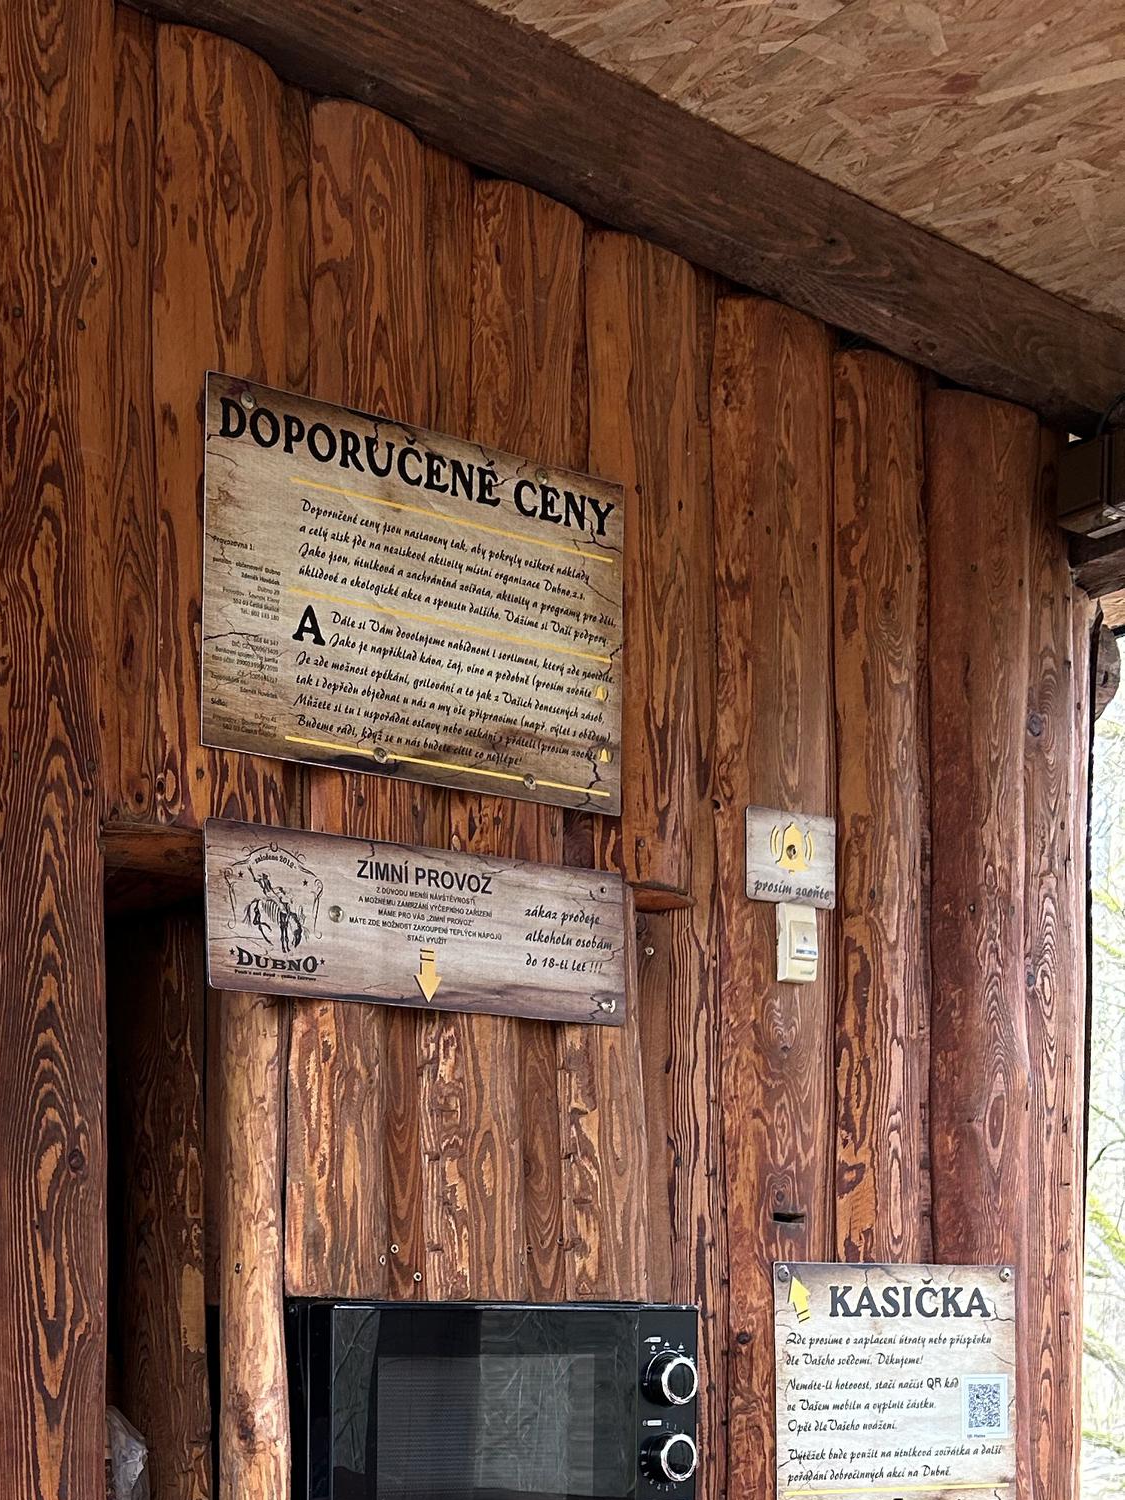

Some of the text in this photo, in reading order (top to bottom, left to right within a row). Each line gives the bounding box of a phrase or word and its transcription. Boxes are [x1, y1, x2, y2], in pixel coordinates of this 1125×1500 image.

[220, 398, 615, 537] DOPORUČENÉ CENY
[301, 498, 590, 586] Doporučené ceny jsou nastaveny tak, aby pokryly veškeré náklady
[308, 526, 540, 589] celý zisk jde na neziskové aktivity místní organizace
[298, 542, 326, 559] Jako
[328, 551, 350, 566] jsou,
[353, 556, 395, 575] útulková
[406, 570, 458, 589] zachráněná
[496, 590, 530, 611] aktivity
[540, 603, 581, 622] programy
[582, 612, 597, 624] pro
[298, 565, 339, 583] úklidové
[350, 576, 399, 596] ekologické
[401, 588, 422, 602] akce
[432, 598, 467, 612] spoustu
[504, 609, 539, 629] Vážíme
[540, 621, 548, 631] si
[550, 620, 572, 636] Vaší
[292, 605, 326, 646] A
[329, 633, 356, 649] Jako
[358, 641, 368, 655] je
[370, 646, 417, 661] například
[419, 651, 444, 668] káva,
[466, 664, 485, 676] víno
[495, 670, 530, 685] podobně
[331, 611, 356, 628] Dále
[357, 621, 366, 630] si
[369, 619, 394, 636] Vám
[396, 626, 445, 647] dovolujeme
[447, 639, 490, 657] nabídnout
[542, 658, 565, 677] který
[566, 664, 580, 676] zde
[295, 650, 311, 666] Je
[313, 655, 329, 668] zde
[331, 662, 368, 676] možnost
[413, 678, 454, 693] grilování
[476, 689, 492, 702] jak
[502, 691, 532, 709] Vašich
[296, 674, 313, 686] tak
[322, 677, 359, 695] dopředu
[361, 685, 400, 703] objednat
[411, 697, 427, 708] nás
[453, 704, 466, 716] vše
[293, 693, 331, 711] Můžete
[363, 710, 410, 725] uspořádat
[411, 718, 441, 735] oslavy
[442, 722, 463, 735] nebo
[295, 714, 334, 732] Budeme
[357, 859, 492, 894] ZIMNÍ PROVOZ
[754, 879, 831, 900] prosím zvoňte
[525, 904, 600, 929] zákaz prodeje
[525, 929, 612, 950] alkoholu osobám
[236, 946, 318, 973] DUBNO
[525, 952, 538, 967] do
[571, 959, 587, 972] let
[830, 1279, 990, 1318] KASIČKA
[808, 1335, 843, 1349] prosíme
[853, 1333, 897, 1349] zaplacení
[899, 1334, 926, 1348] útraty
[928, 1333, 947, 1345] nebo
[786, 1353, 799, 1366] dle
[802, 1353, 835, 1366] Vašeho
[876, 1352, 924, 1368] Děkujeme!
[874, 1379, 896, 1390] stačí
[898, 1379, 924, 1389] načíst
[926, 1377, 942, 1391] QR
[785, 1399, 796, 1412] ve
[799, 1398, 830, 1411] Vašem
[832, 1399, 862, 1411] mobilu
[872, 1400, 904, 1414] vyplnit
[787, 1419, 812, 1436] Opět
[814, 1420, 829, 1432] dle
[827, 1419, 860, 1431] Vašeho
[786, 1448, 826, 1465] Výtěžek
[828, 1448, 847, 1460] bude
[880, 1450, 892, 1458] na
[787, 1467, 828, 1486] pořádání
[829, 1467, 884, 1483] dobročinných
[886, 1466, 906, 1478] akcí
